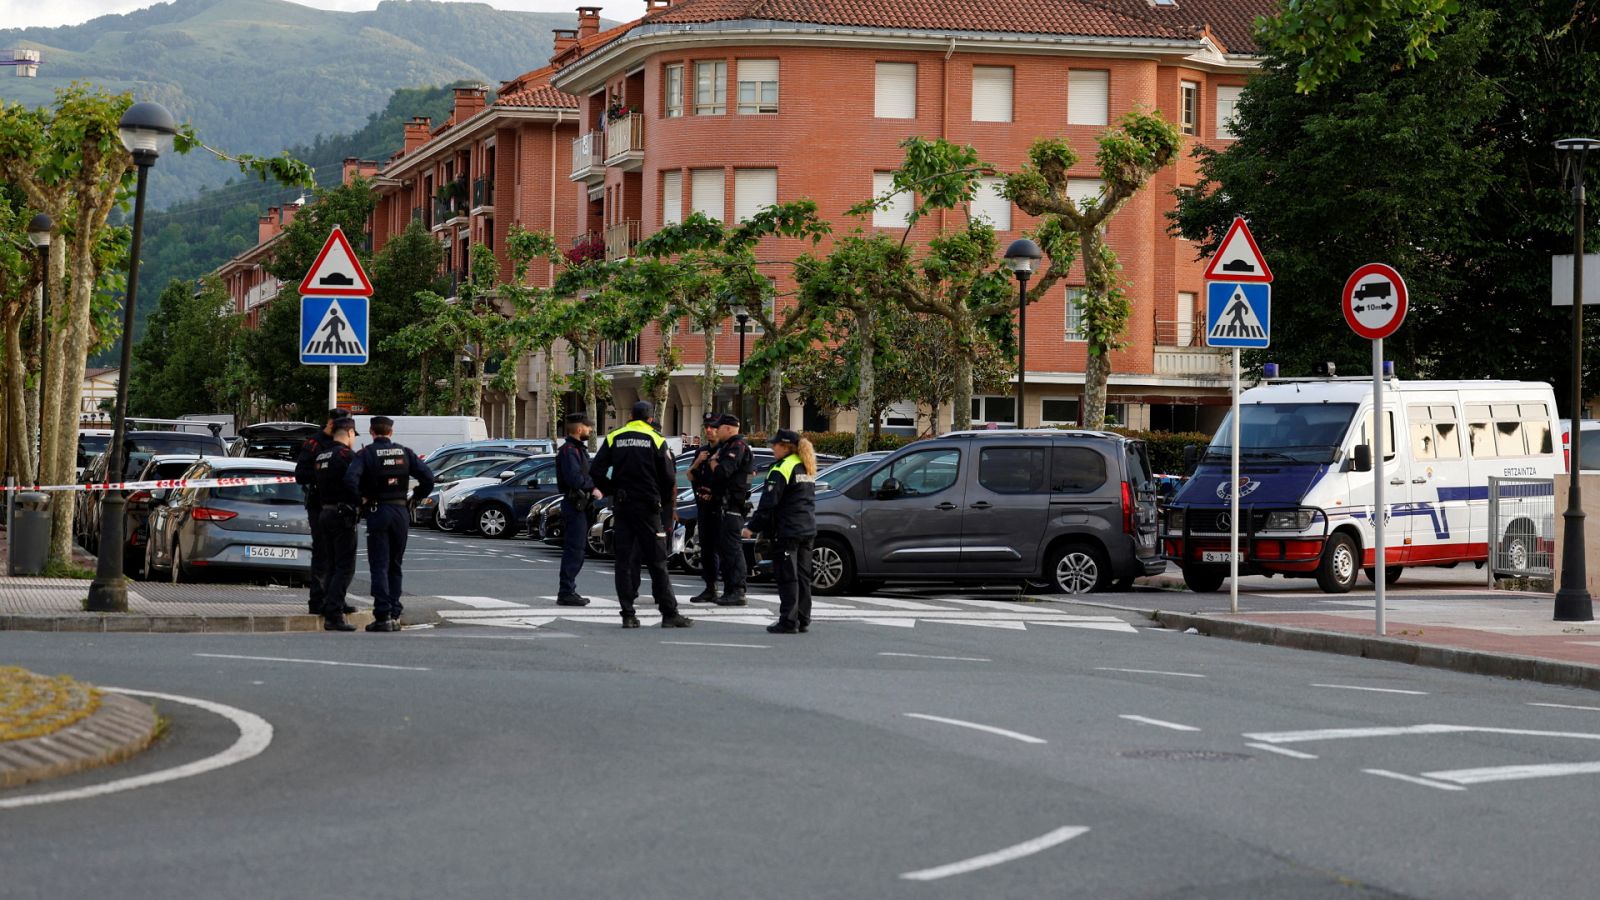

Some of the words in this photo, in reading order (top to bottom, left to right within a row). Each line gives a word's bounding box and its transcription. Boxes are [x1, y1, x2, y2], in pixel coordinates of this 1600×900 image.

[1504, 467, 1536, 476] ERTZAINTZA
[251, 547, 275, 557] 5464
[278, 548, 296, 559] JPX
